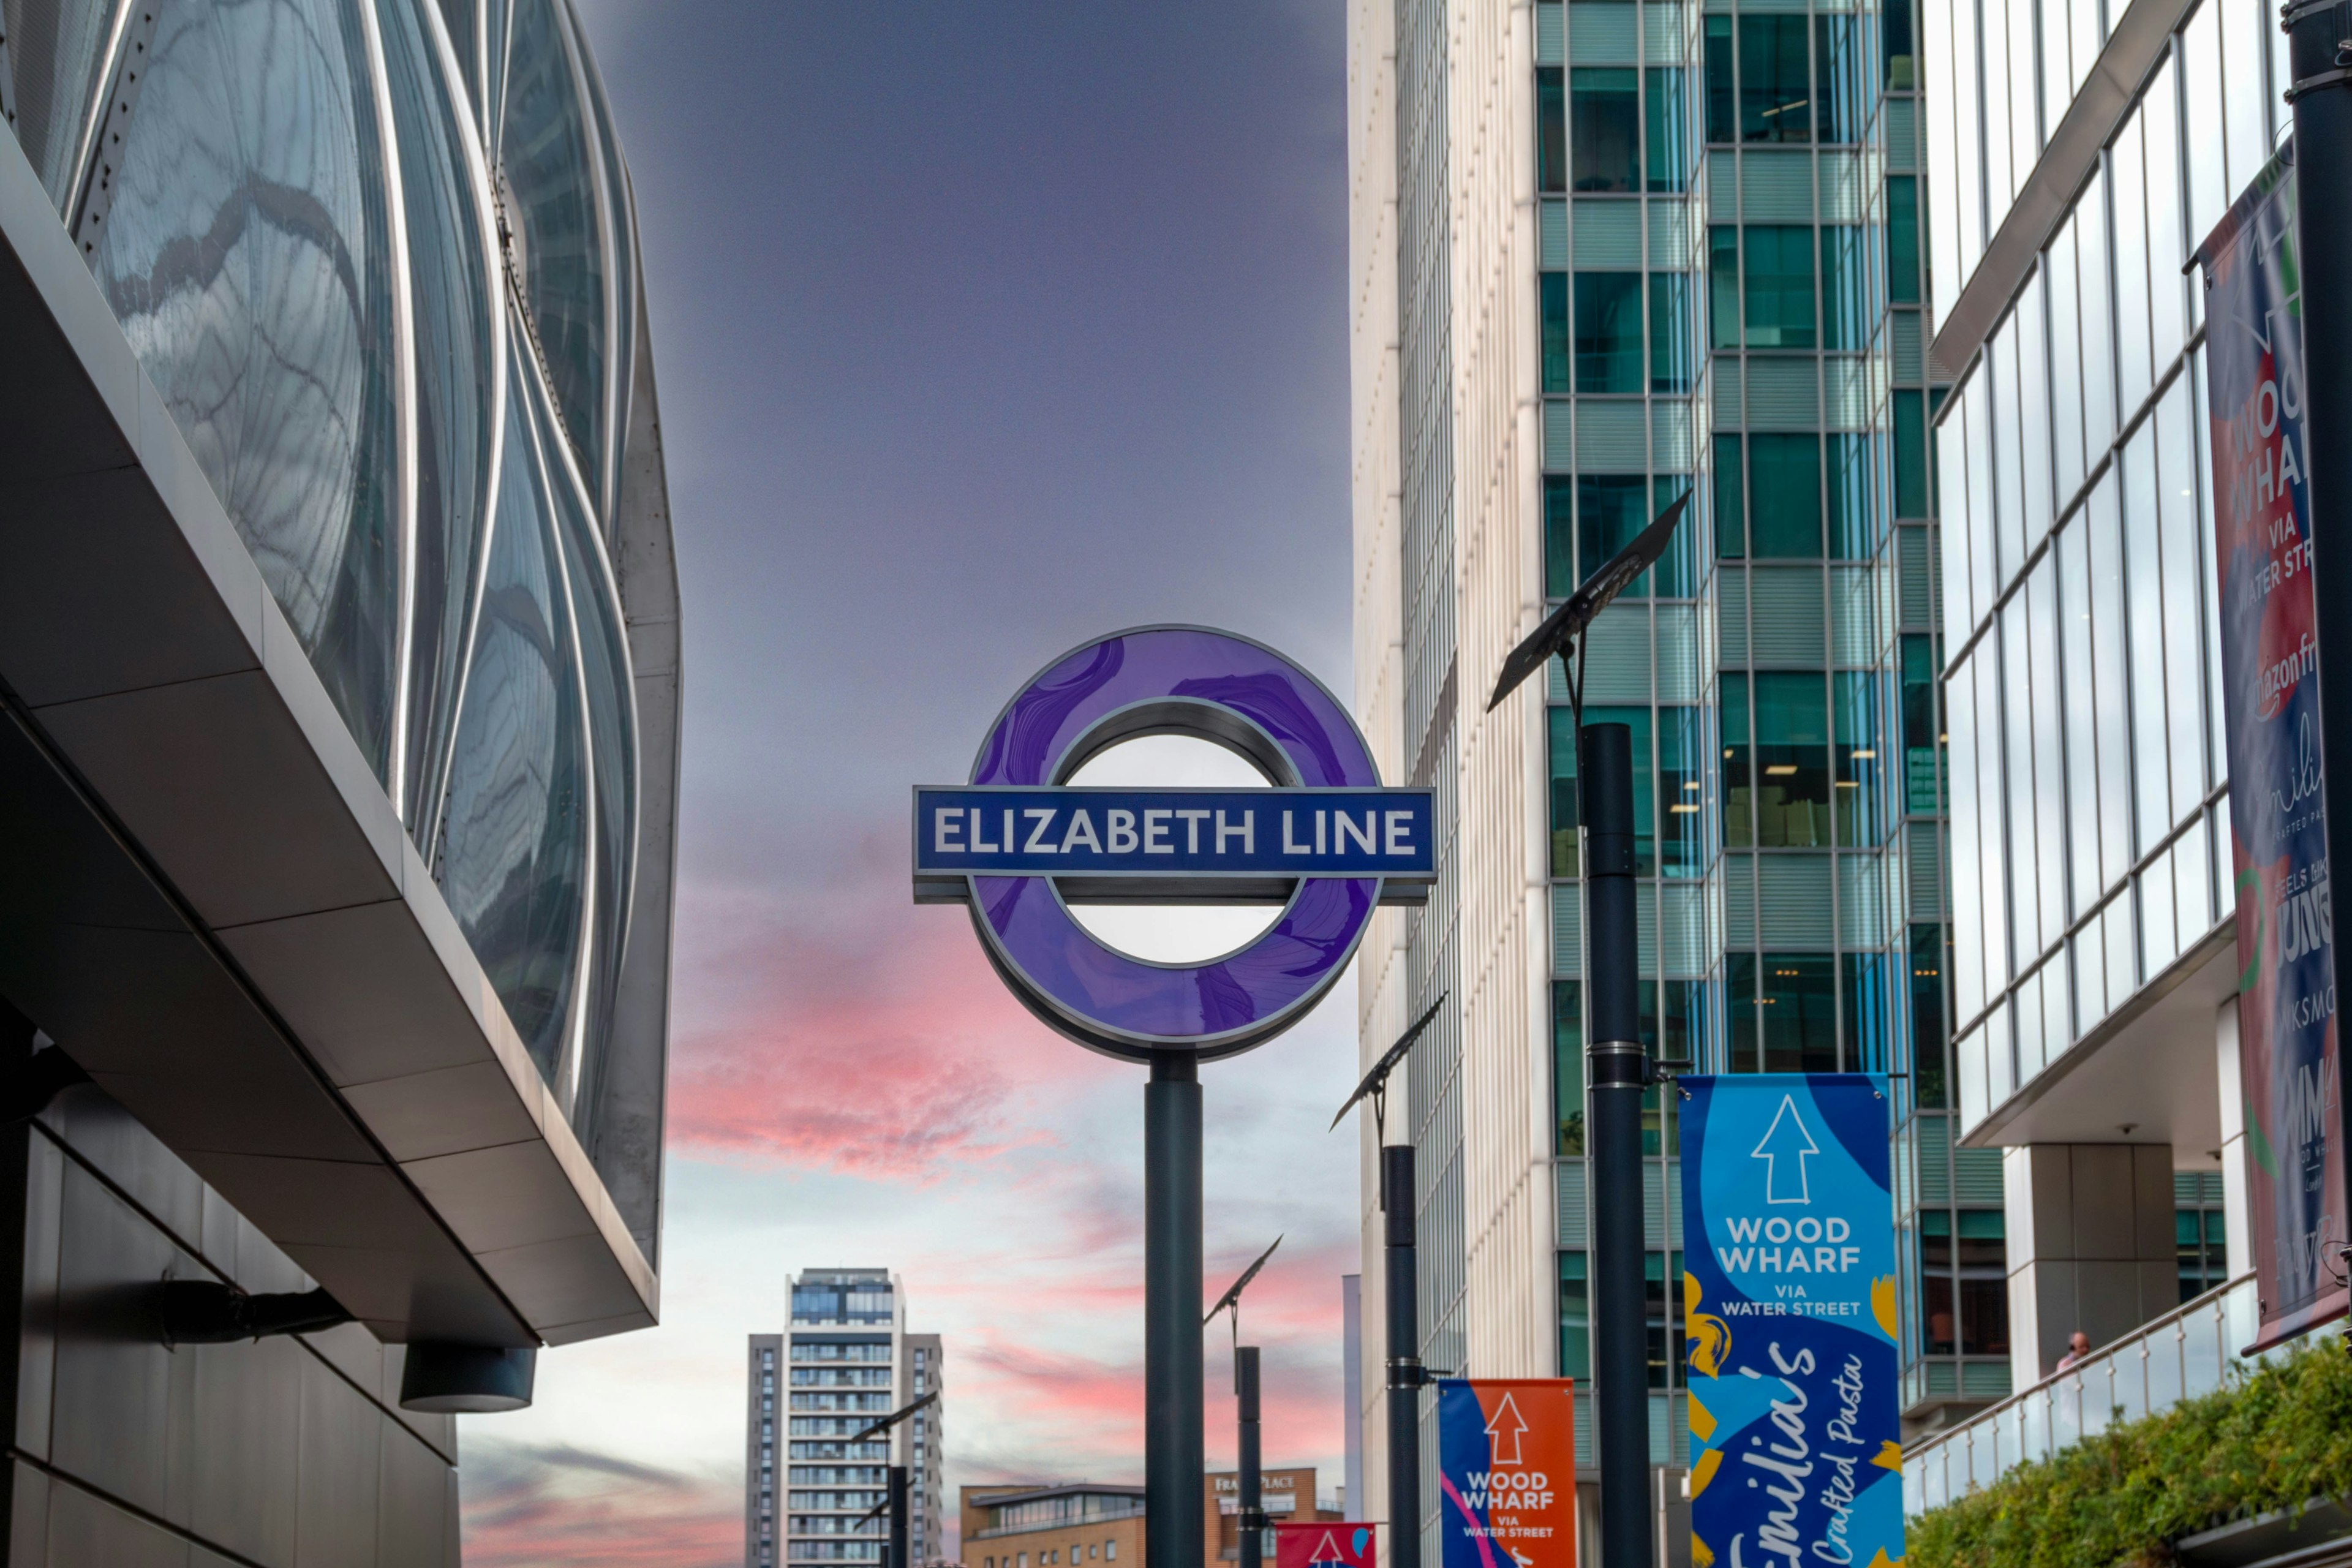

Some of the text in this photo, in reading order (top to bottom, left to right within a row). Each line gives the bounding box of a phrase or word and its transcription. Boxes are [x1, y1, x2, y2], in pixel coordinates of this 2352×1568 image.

[2232, 364, 2304, 463] WOO
[2269, 511, 2296, 549] VIA
[2238, 559, 2280, 612] WATER
[2252, 652, 2299, 706] mazon
[934, 807, 1416, 856] ELIZABETH LINE
[1726, 1217, 1850, 1243] WOOD
[1717, 1247, 1860, 1273] WHARF
[1775, 1285, 1806, 1298] VIA
[1722, 1302, 1860, 1316] WATER STREET
[1811, 1354, 1866, 1565] Crafted Pasta
[1467, 1472, 1548, 1490] WOOD
[1461, 1491, 1554, 1510] WHARF
[1463, 1528, 1553, 1537] WATER STREET
[1498, 1516, 1519, 1526] VIA
